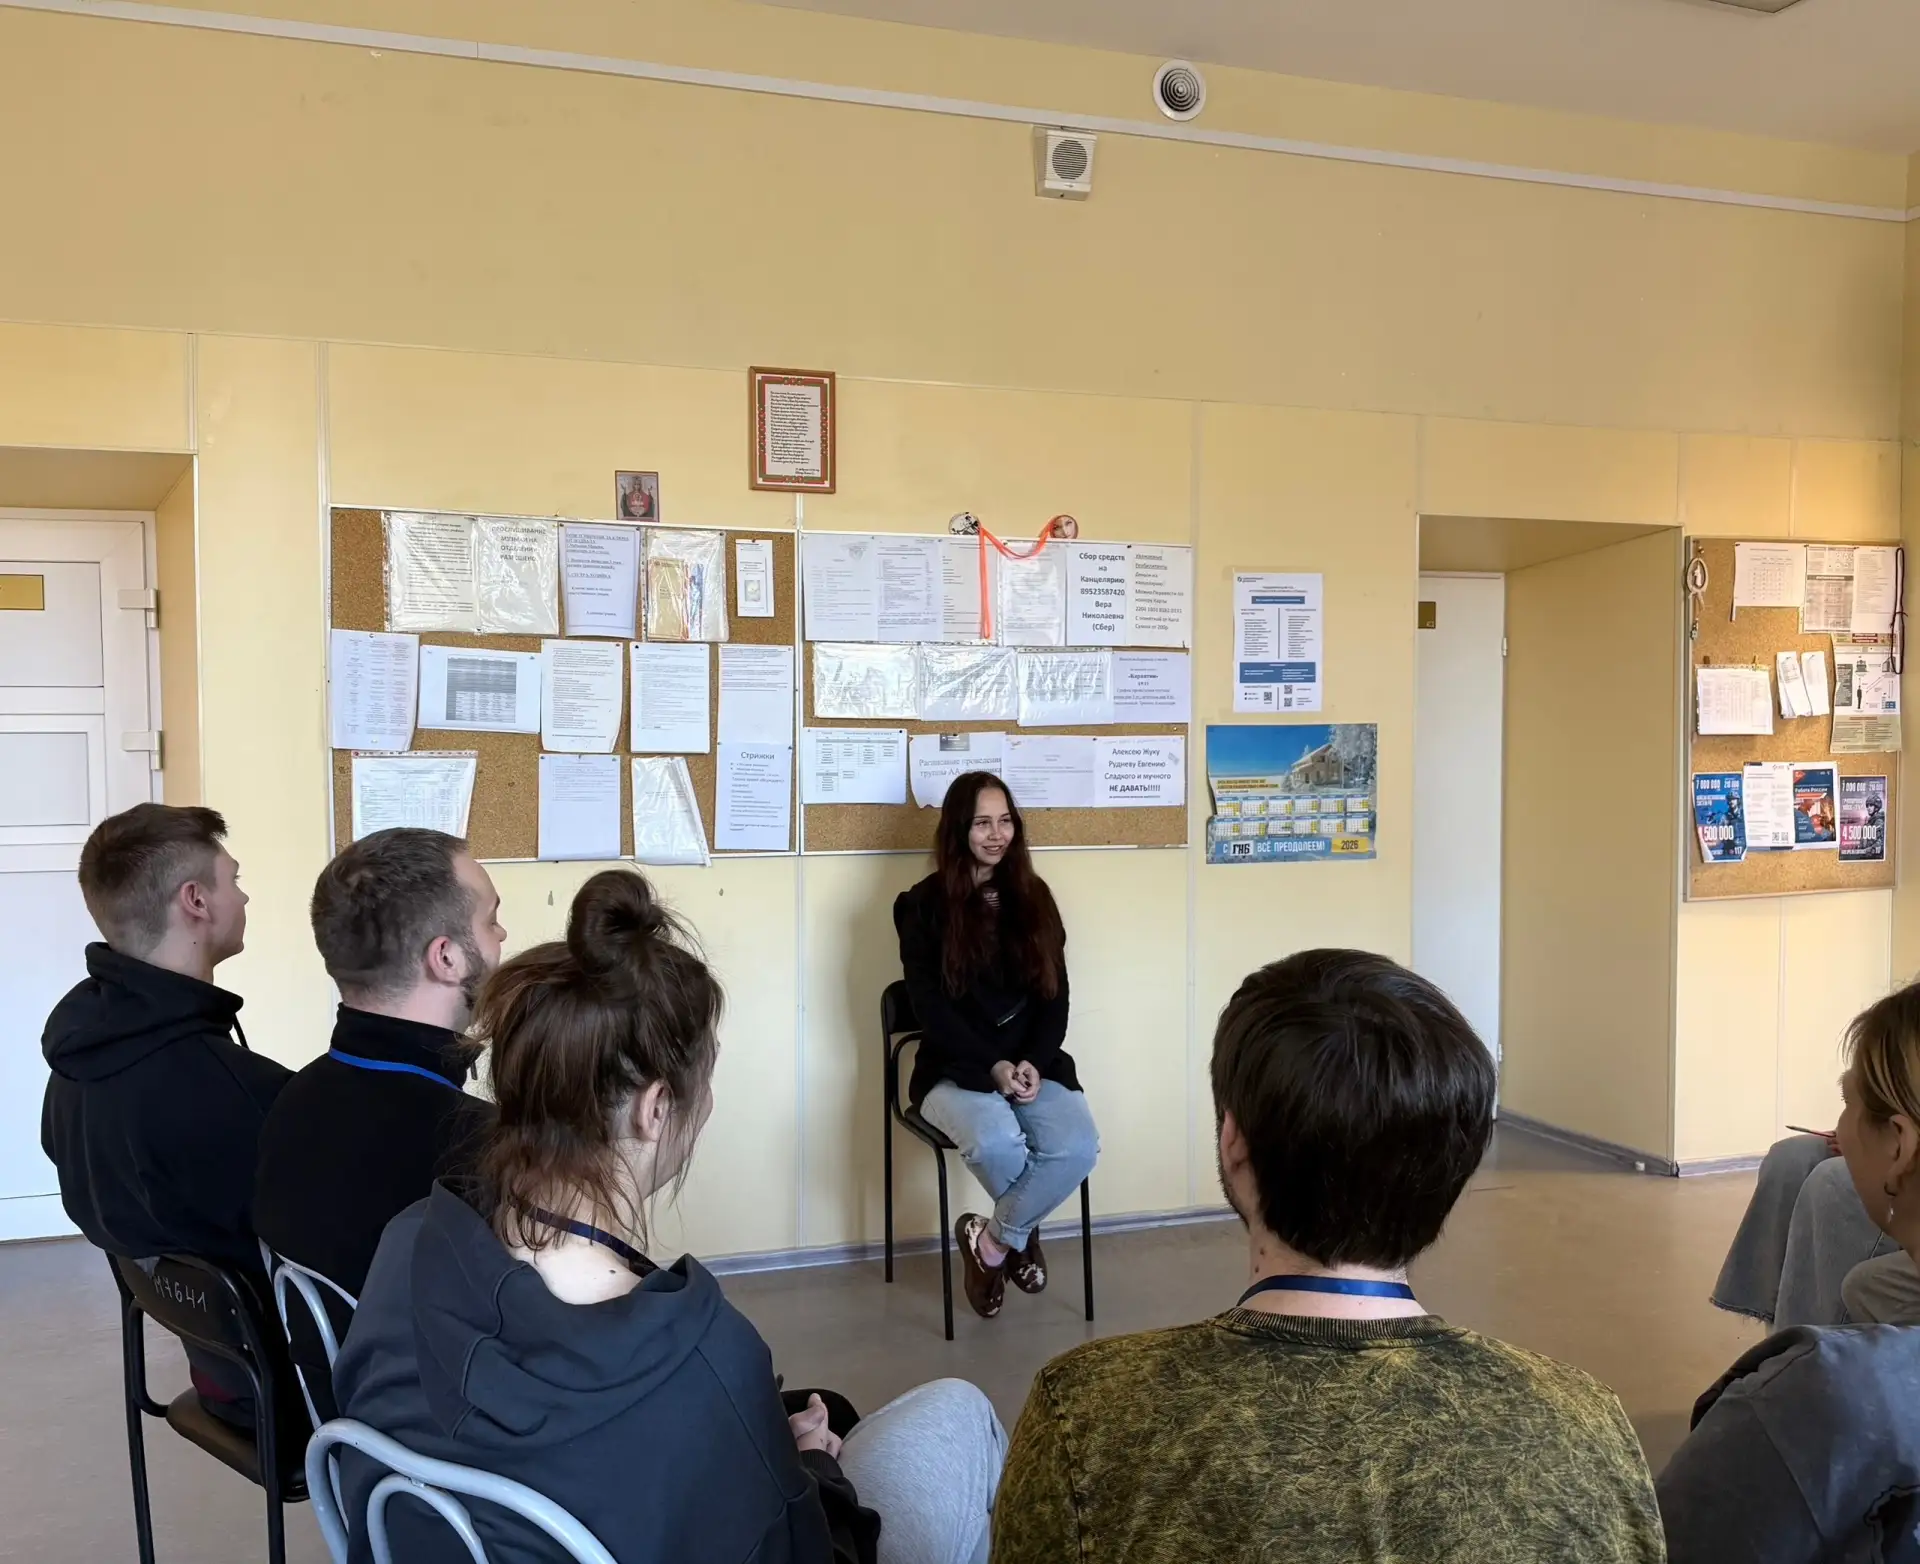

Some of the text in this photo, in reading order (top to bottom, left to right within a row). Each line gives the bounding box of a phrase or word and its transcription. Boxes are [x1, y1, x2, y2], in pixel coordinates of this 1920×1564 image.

[1079, 552, 1097, 561] Сбор
[1080, 576, 1125, 584] Канцелярию
[1095, 601, 1112, 609] Вера
[1082, 612, 1124, 620] Николаевна
[1092, 623, 1115, 631] (Сбер)
[740, 751, 775, 760] Стрижки
[1112, 748, 1160, 757] Алексею Жуку
[1108, 760, 1166, 768] Рудневу Евгению
[1104, 772, 1136, 780] Сладкого
[1704, 826, 1718, 841] 500
[1719, 825, 1734, 841] 000
[1842, 825, 1877, 840] 4 500 000
[1222, 844, 1228, 853] С
[1232, 843, 1251, 855] ГНБ
[1274, 841, 1325, 853] ПРЕОДОЛЕЕМ!
[1341, 840, 1359, 850] 2026
